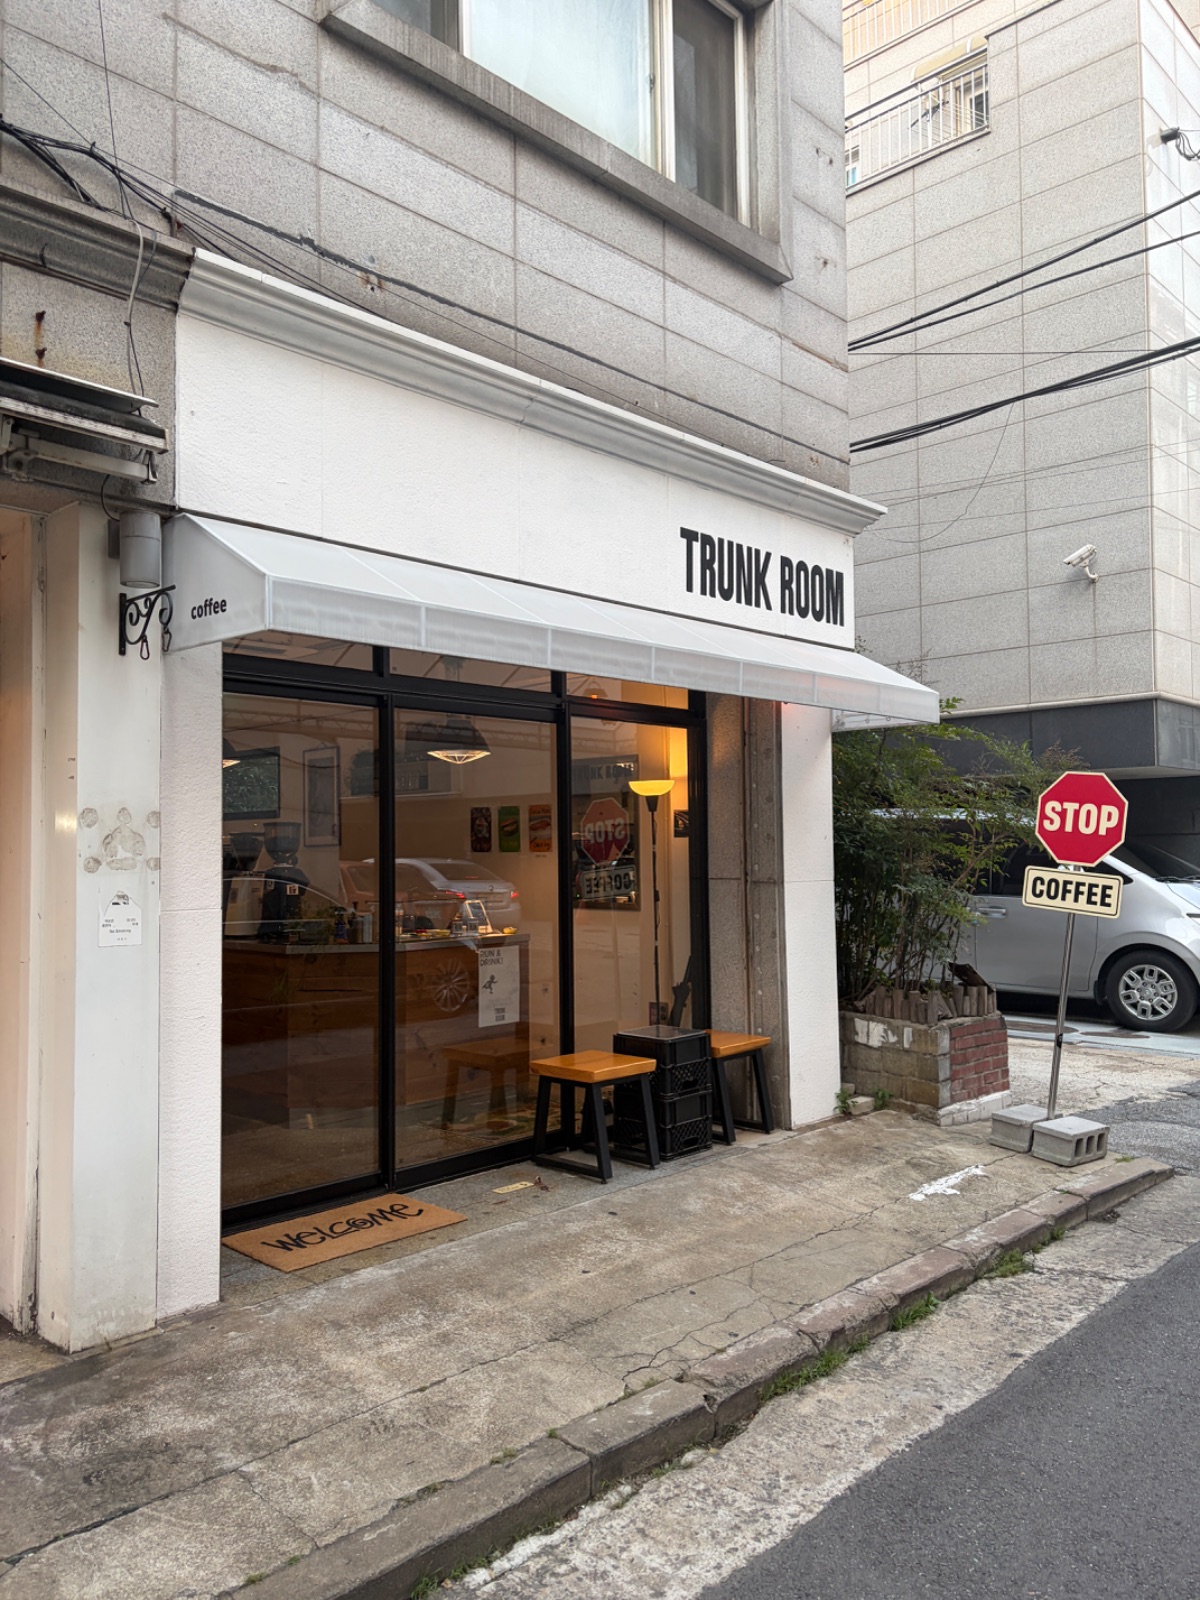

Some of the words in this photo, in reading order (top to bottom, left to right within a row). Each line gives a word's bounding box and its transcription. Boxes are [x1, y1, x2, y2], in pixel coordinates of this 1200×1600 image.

[680, 526, 773, 611] TRUNK
[780, 555, 844, 627] ROOM
[191, 597, 227, 620] coffee
[1042, 800, 1120, 836] STOP
[1031, 876, 1114, 908] COFFEE
[479, 949, 495, 958] RUN
[496, 949, 501, 957] &
